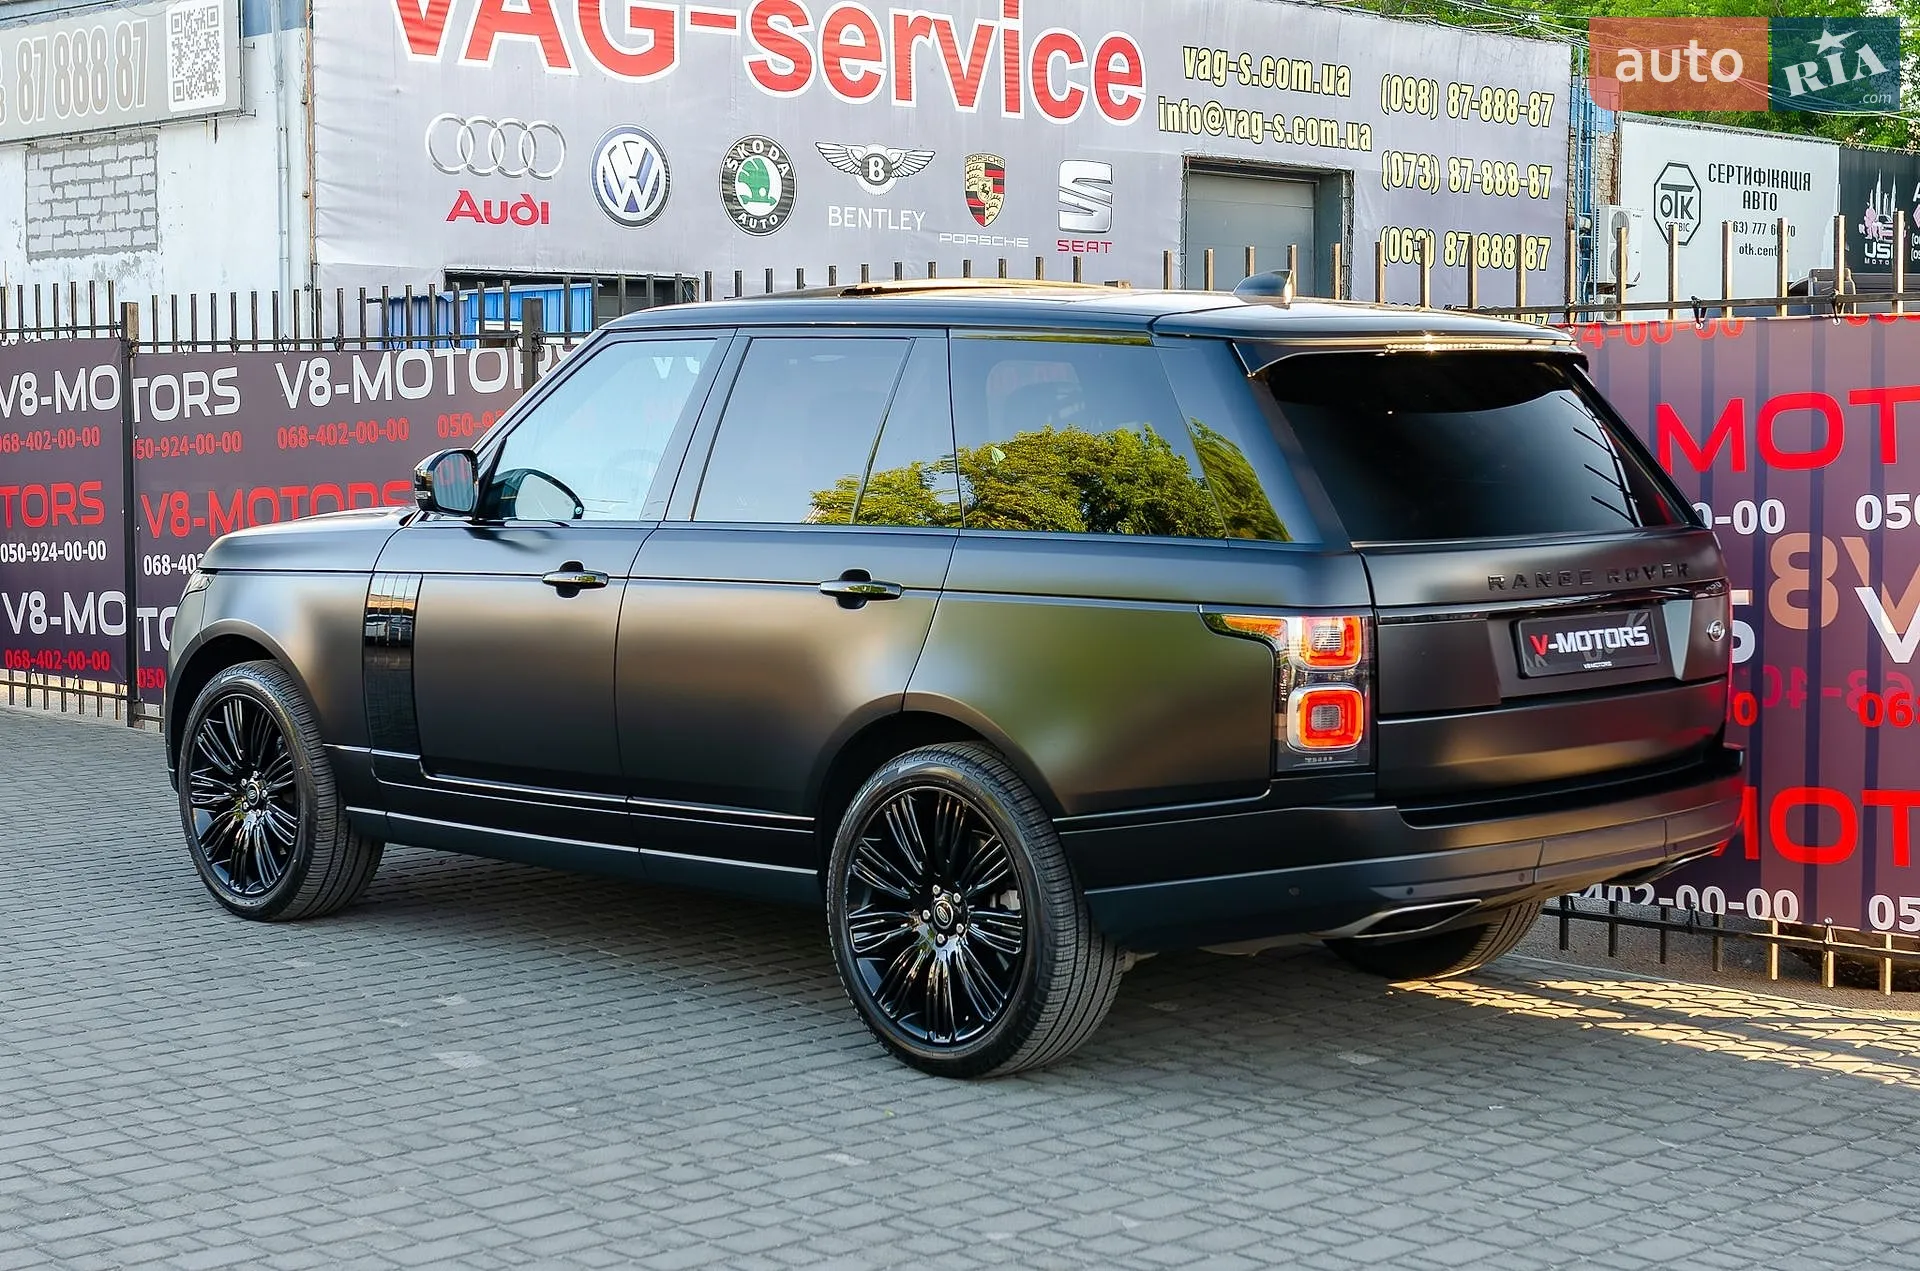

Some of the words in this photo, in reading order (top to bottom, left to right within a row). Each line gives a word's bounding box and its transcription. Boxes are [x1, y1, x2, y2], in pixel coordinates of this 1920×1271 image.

[16, 36, 48, 125] 87
[53, 25, 109, 120] 888
[115, 19, 149, 112] 87
[1183, 45, 1352, 97] vag-s.com.ua
[1380, 74, 1439, 121] (098)
[1446, 81, 1555, 128] 87-888-87
[1157, 96, 1373, 152] info@vag-s.com.ua
[1381, 150, 1441, 195] (073)
[1447, 156, 1553, 200] 87-888-87
[1708, 163, 1812, 193] СЕРТИФІКАЦІЯ
[445, 190, 550, 225] Audi
[1742, 190, 1779, 213] АВТО
[738, 213, 779, 230] AUTO
[827, 205, 927, 232] BENTLEY
[1664, 221, 1691, 233] СВІС
[1752, 221, 1767, 235] 777
[938, 232, 1030, 249] PORSCHE
[1056, 239, 1113, 254] SEAT
[133, 430, 243, 460] 50-924-00-00
[277, 417, 410, 450] 068-402-00-00
[0, 540, 107, 562] 050-924-00-00
[143, 553, 203, 576] 068-40
[1487, 569, 1593, 591] RANGE
[1607, 562, 1689, 584] ROVER
[1529, 625, 1650, 656] V-MOTORS
[4, 649, 111, 671] 068-402-00-00
[1858, 692, 1920, 729] 06
